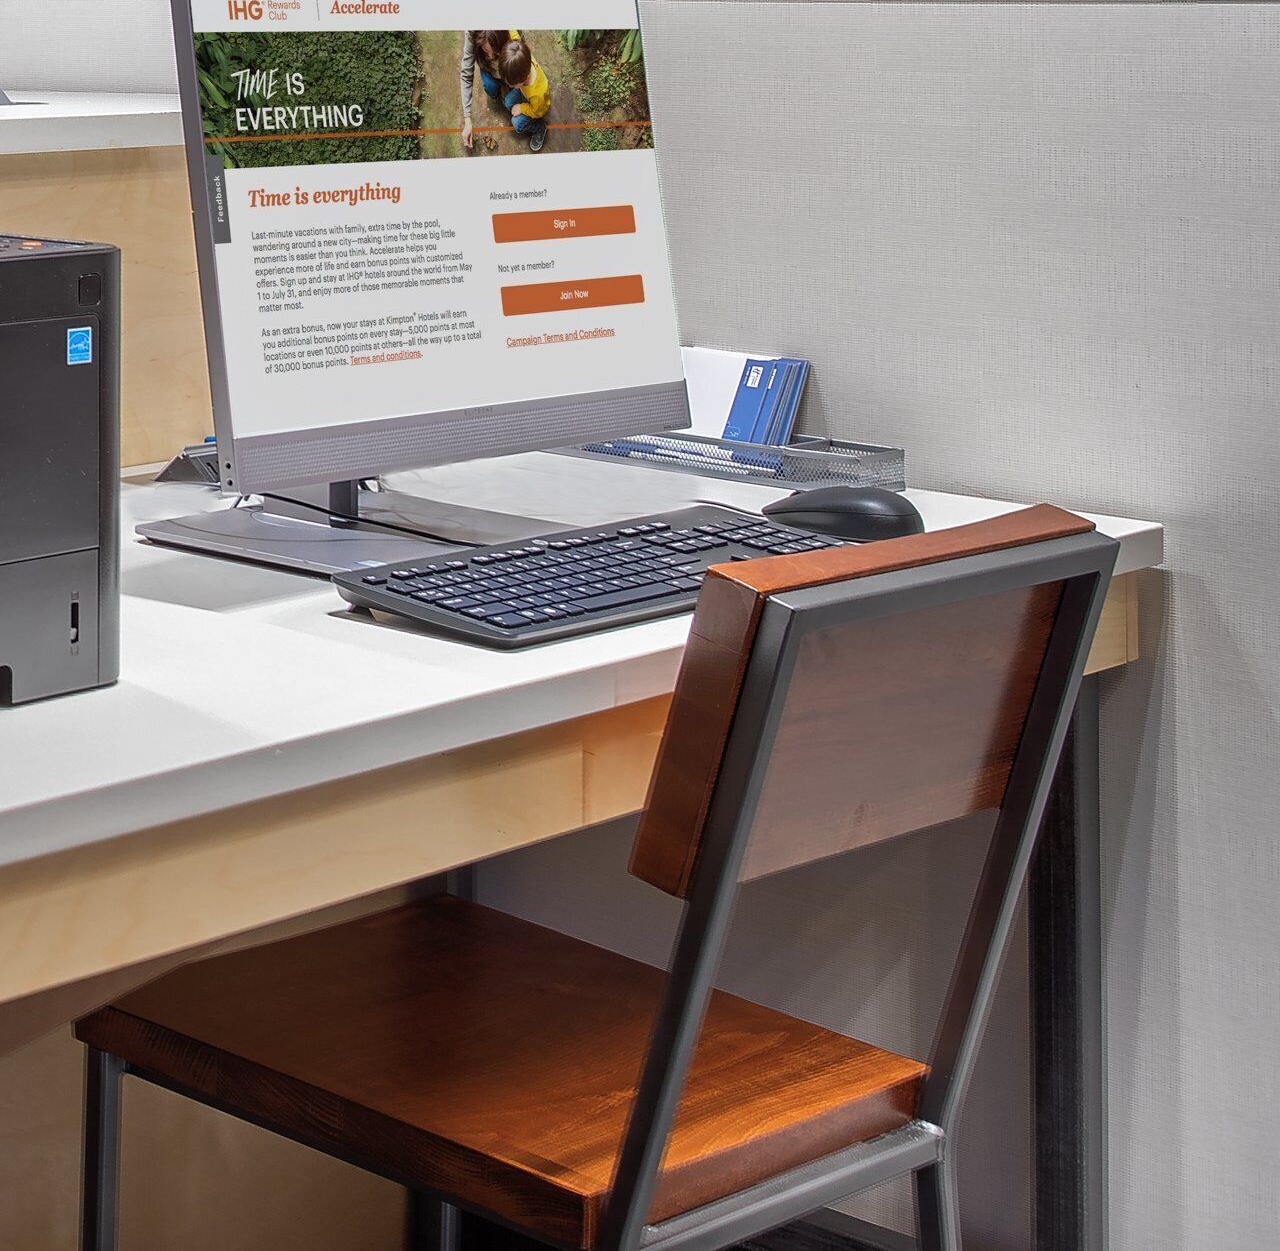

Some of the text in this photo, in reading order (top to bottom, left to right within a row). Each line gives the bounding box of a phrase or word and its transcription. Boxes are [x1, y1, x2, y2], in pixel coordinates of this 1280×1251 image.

[267, 0, 301, 10] Rewards
[330, 0, 400, 14] Accelerate
[268, 10, 287, 21] Club
[230, 68, 305, 101] TIME IS
[235, 104, 364, 131] EVERYTHING
[213, 175, 225, 223] Feedback
[248, 182, 401, 208] Time is everything
[489, 190, 513, 201] Already
[519, 189, 547, 199] member?
[251, 218, 440, 240] Last-minute vacations with family, extra time by the pool,
[553, 218, 576, 231] Sign In
[255, 251, 463, 278] experience more of life and earn bonus points with customized
[498, 264, 510, 273] Not
[510, 264, 521, 274] yet
[526, 260, 555, 271] member?
[560, 289, 589, 300] Join Now
[506, 327, 615, 347] Campaign Terms and Conditions
[265, 350, 423, 374] of 30,000 bonus points. Terms and conditions.
